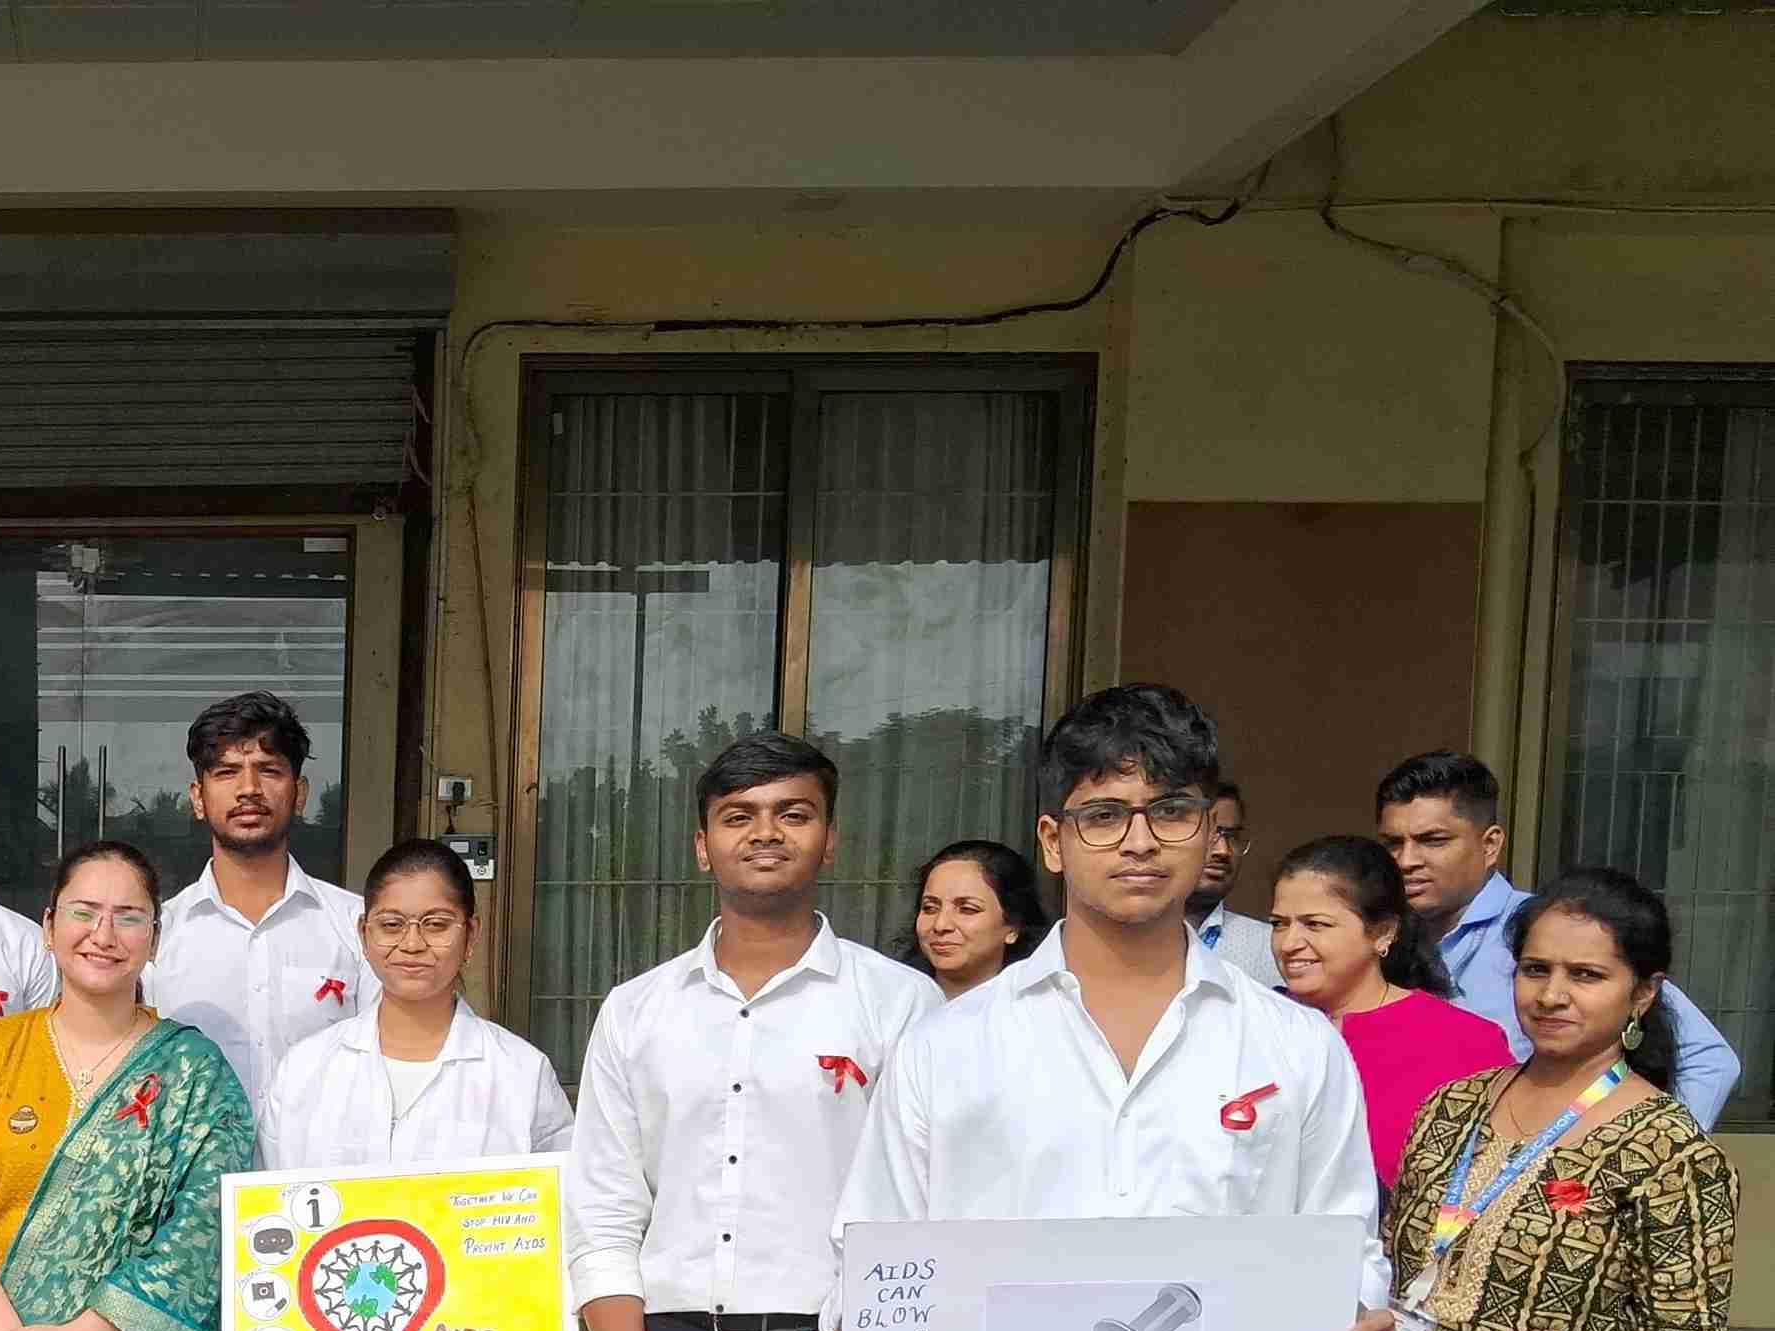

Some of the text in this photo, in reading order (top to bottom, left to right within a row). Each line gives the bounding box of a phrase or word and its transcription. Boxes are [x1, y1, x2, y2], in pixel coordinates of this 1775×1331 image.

[513, 1236, 546, 1250] AIDS
[864, 1258, 937, 1281] AIDS
[877, 1285, 927, 1303] CAN
[857, 1305, 937, 1328] BLOW
